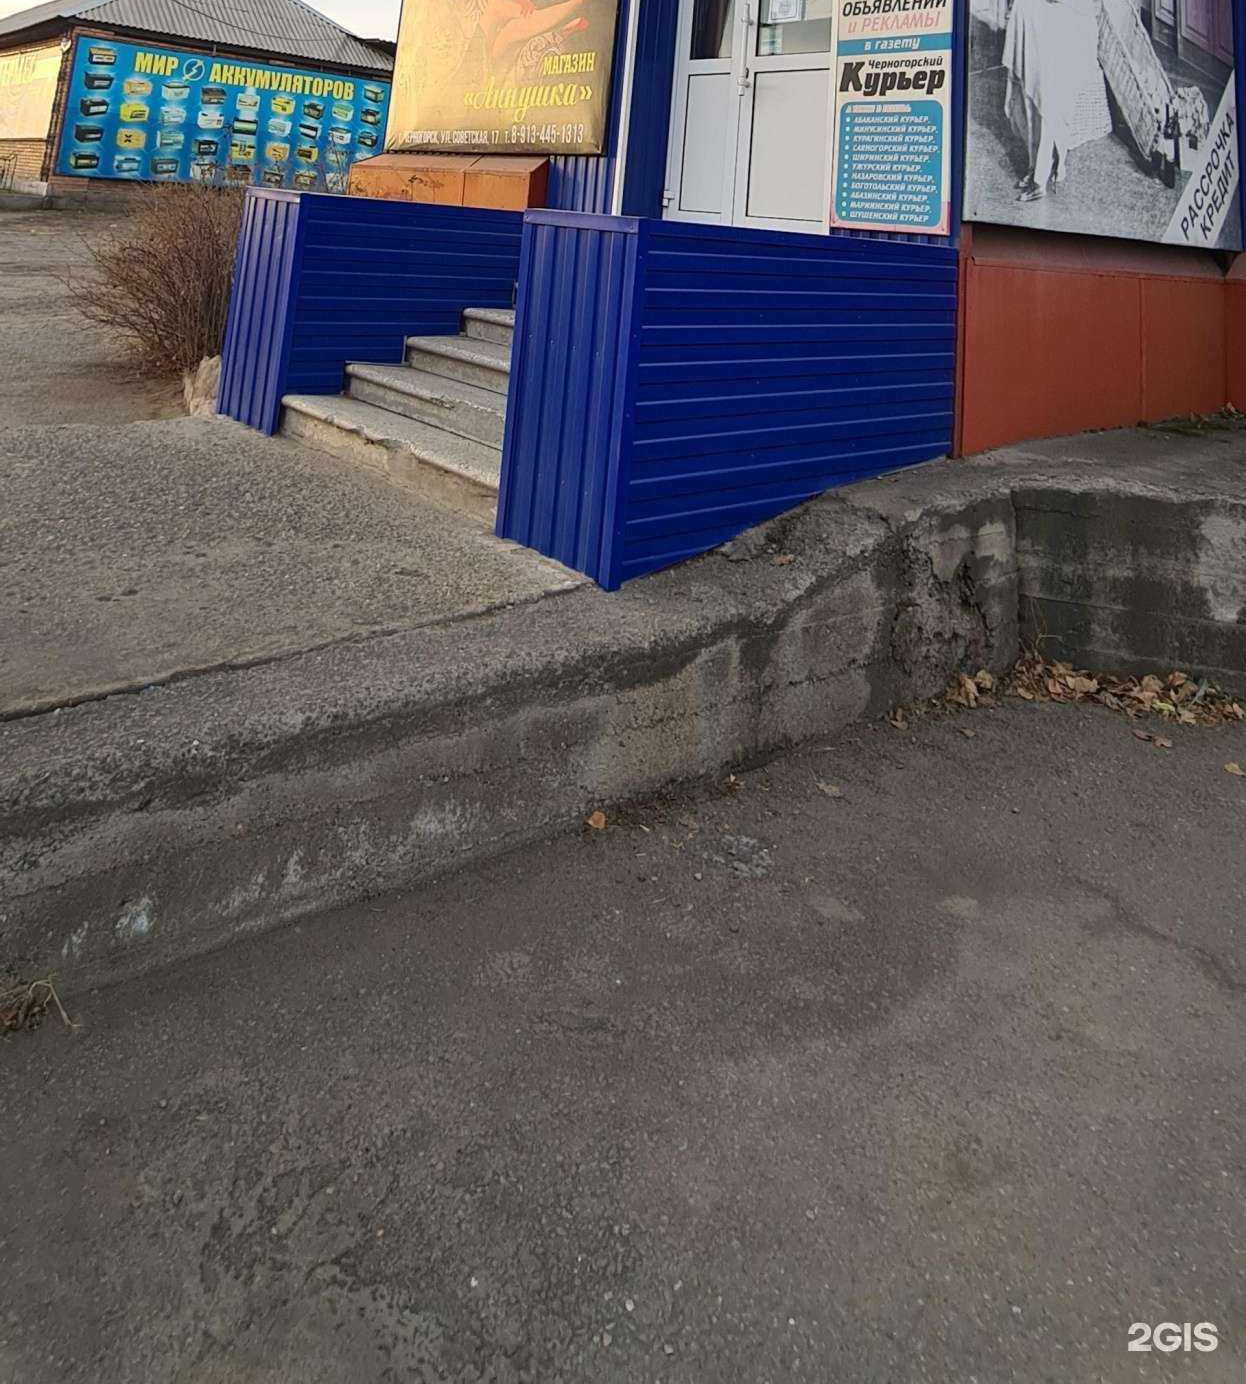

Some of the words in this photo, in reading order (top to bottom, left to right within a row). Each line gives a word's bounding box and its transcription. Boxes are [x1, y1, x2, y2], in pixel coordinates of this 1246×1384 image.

[848, 21, 858, 34] и
[861, 11, 941, 33] РЕКЛАМЫ
[864, 40, 872, 51] в
[875, 37, 921, 51] газету
[543, 52, 596, 76] МАГАЗИН
[868, 55, 944, 70] Черногорский
[134, 52, 179, 76] МИР
[209, 63, 354, 101] АККУМУЛЯТОРОВ
[839, 61, 946, 97] Курьер
[491, 129, 500, 145] 17
[1180, 112, 1235, 241] РАССРОЧКА
[1200, 149, 1235, 241] КРЕДИТ
